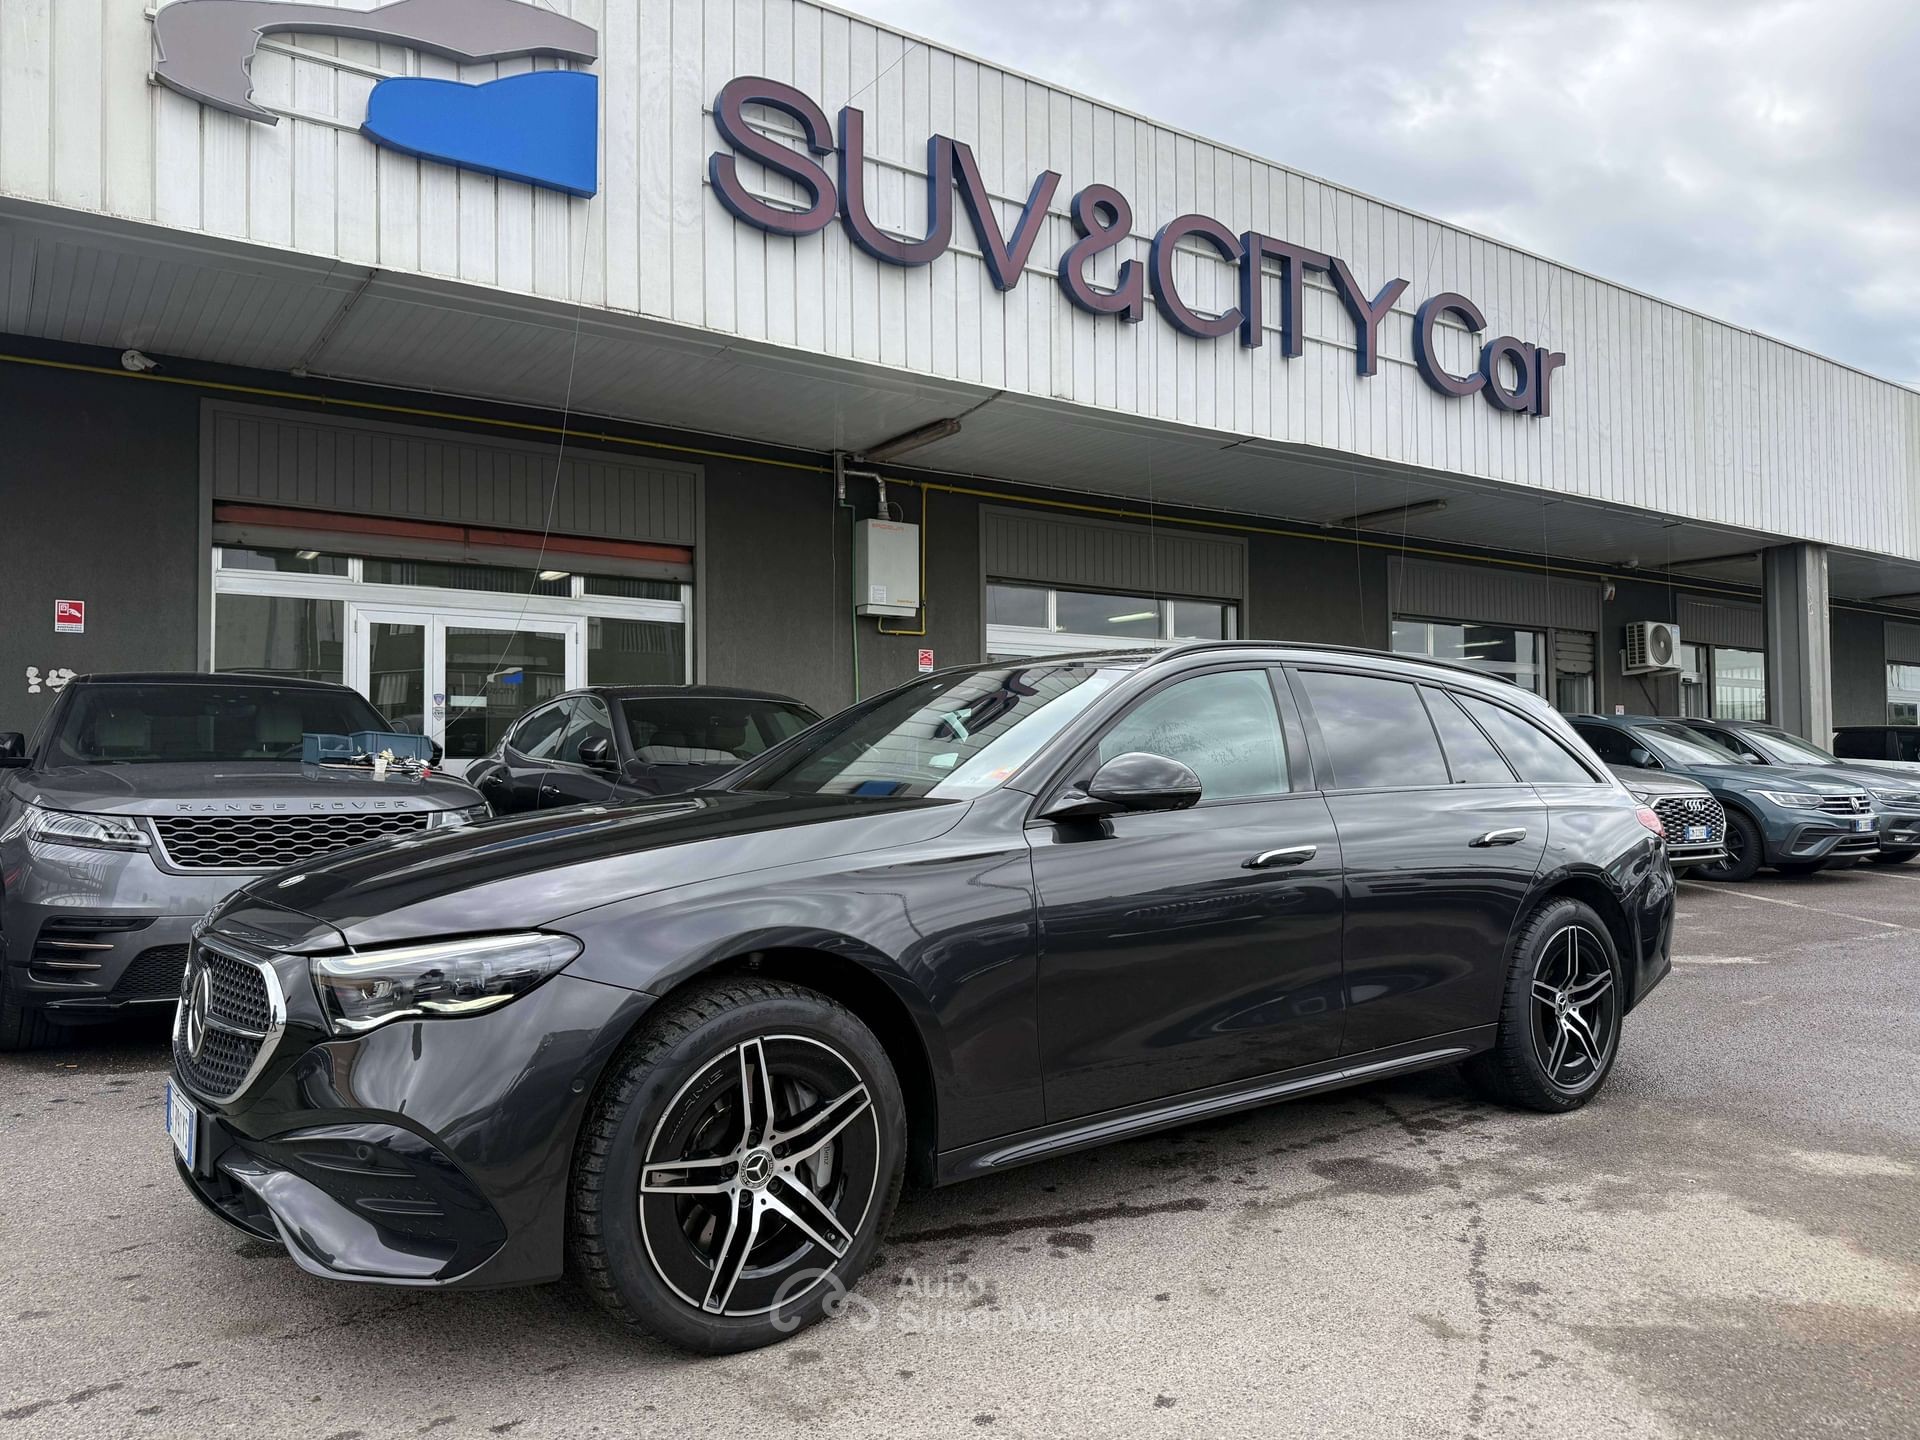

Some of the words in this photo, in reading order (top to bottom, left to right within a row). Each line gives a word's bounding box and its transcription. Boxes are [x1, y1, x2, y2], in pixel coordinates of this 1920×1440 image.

[1414, 292, 1566, 418] Car
[176, 802, 289, 811] RANGE
[309, 800, 409, 810] ROVER
